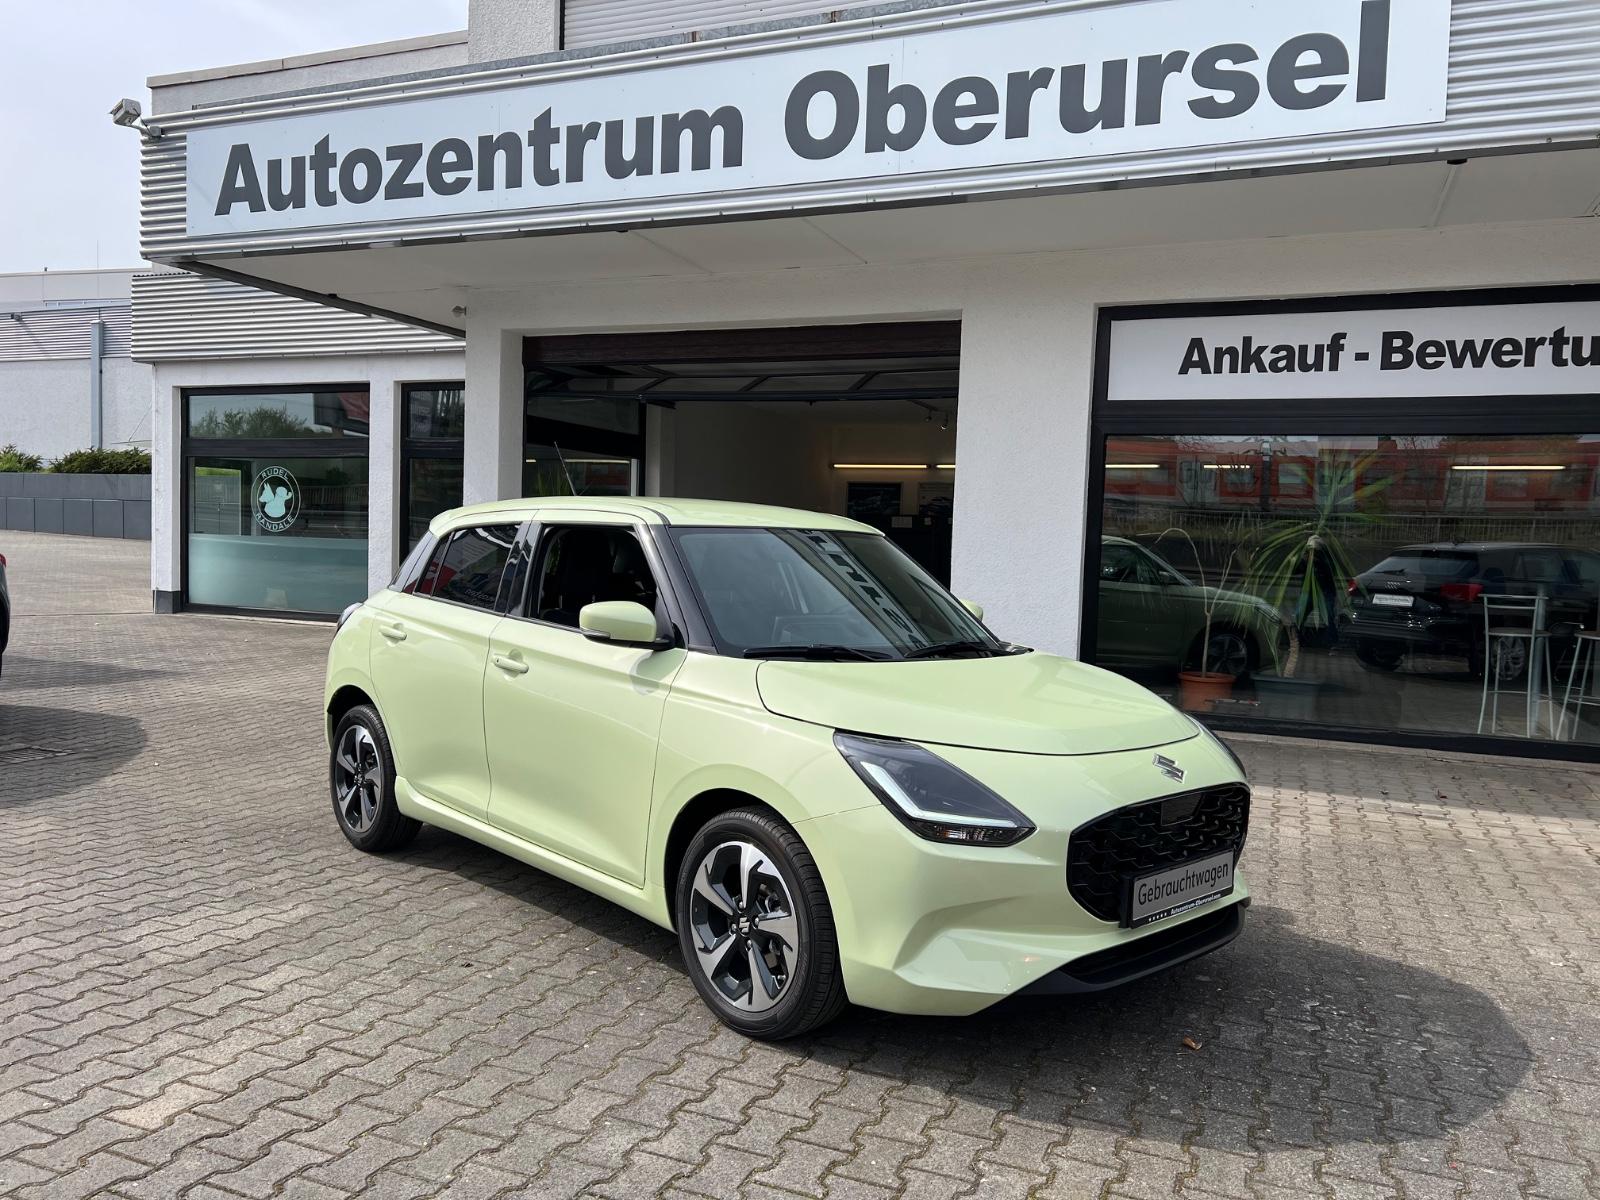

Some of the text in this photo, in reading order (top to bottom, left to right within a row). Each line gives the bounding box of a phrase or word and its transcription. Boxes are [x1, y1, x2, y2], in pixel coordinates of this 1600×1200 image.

[214, 0, 1391, 217] Autozentrum Oberursel
[1178, 332, 1348, 375] Ankauf
[1379, 326, 1600, 371] Bewertu
[261, 467, 289, 480] RUDEL
[255, 512, 294, 530] RANDALE
[1137, 862, 1230, 906] Gebrauchtwagen
